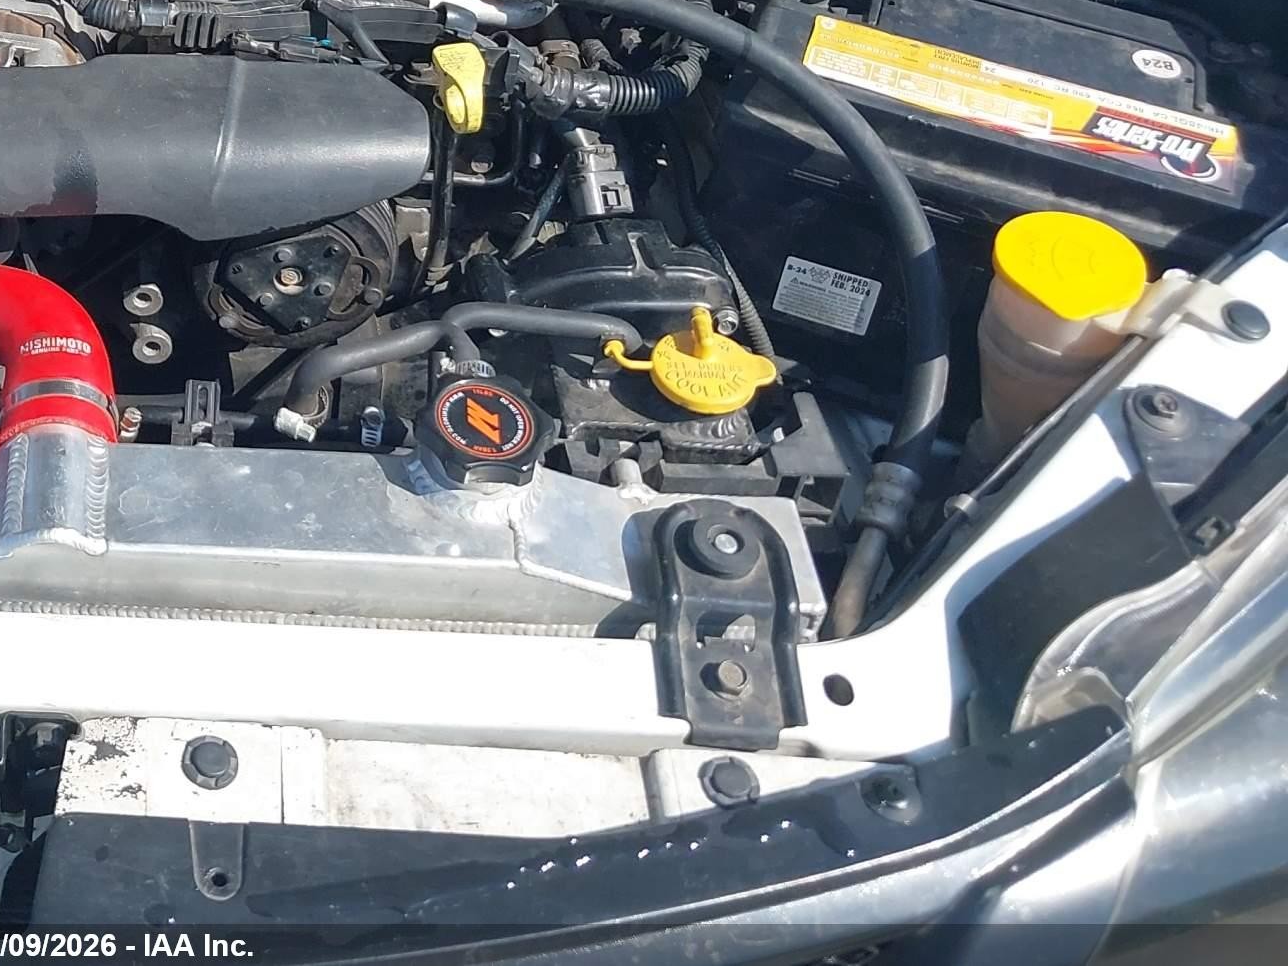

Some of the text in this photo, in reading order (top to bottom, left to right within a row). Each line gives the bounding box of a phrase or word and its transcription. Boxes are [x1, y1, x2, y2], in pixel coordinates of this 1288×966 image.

[1141, 57, 1175, 72] B24
[1091, 116, 1207, 163] Pro-Series
[830, 280, 847, 291] FEB.
[20, 336, 91, 355] MISHIMOTO
